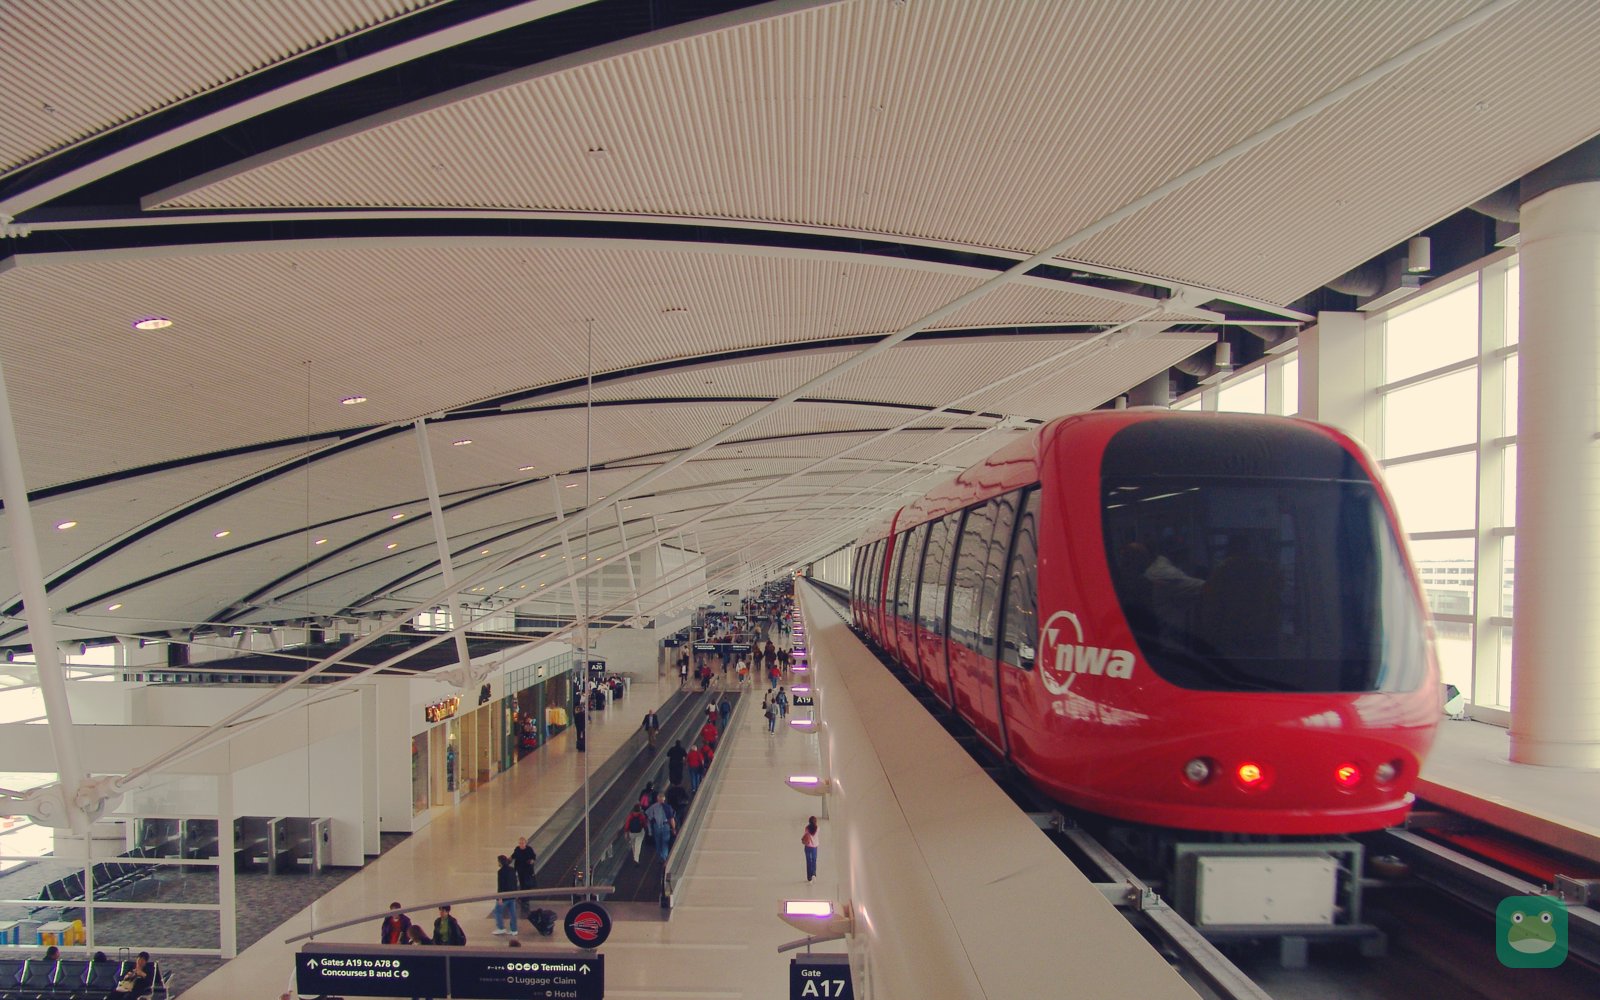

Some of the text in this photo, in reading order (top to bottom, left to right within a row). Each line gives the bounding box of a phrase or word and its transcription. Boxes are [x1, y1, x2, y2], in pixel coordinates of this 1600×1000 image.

[1055, 643, 1136, 680] nwa
[321, 958, 344, 967] Gates
[345, 959, 362, 967] A19
[374, 960, 391, 968] A78
[540, 963, 576, 971] Terminal
[321, 968, 400, 978] Concourses B and C
[801, 969, 822, 977] Gate
[515, 976, 551, 985] Luggage
[553, 976, 576, 985] Claim
[801, 979, 846, 997] A17
[554, 990, 577, 998] Hotel
